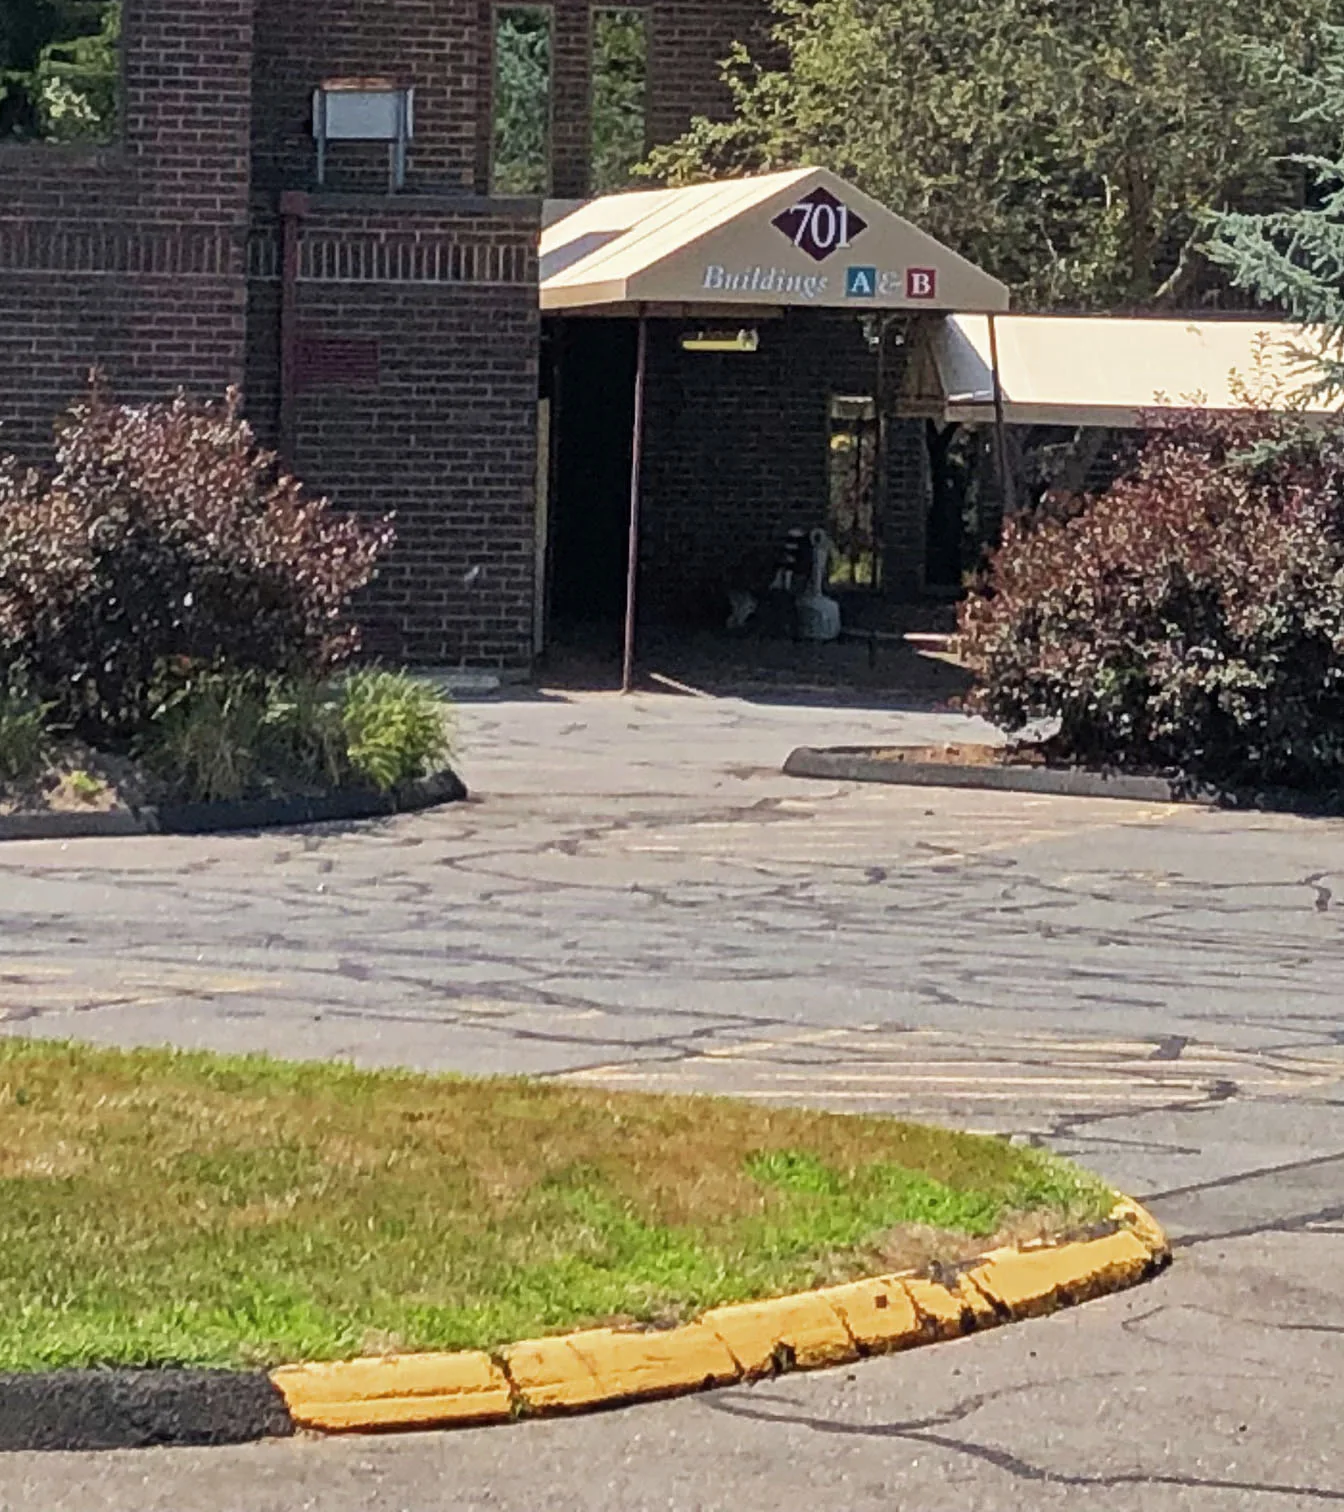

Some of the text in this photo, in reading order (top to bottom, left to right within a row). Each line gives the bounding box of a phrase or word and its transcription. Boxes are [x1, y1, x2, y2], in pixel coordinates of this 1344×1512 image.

[789, 203, 851, 249] 701
[703, 265, 932, 298] Buildings A & B
